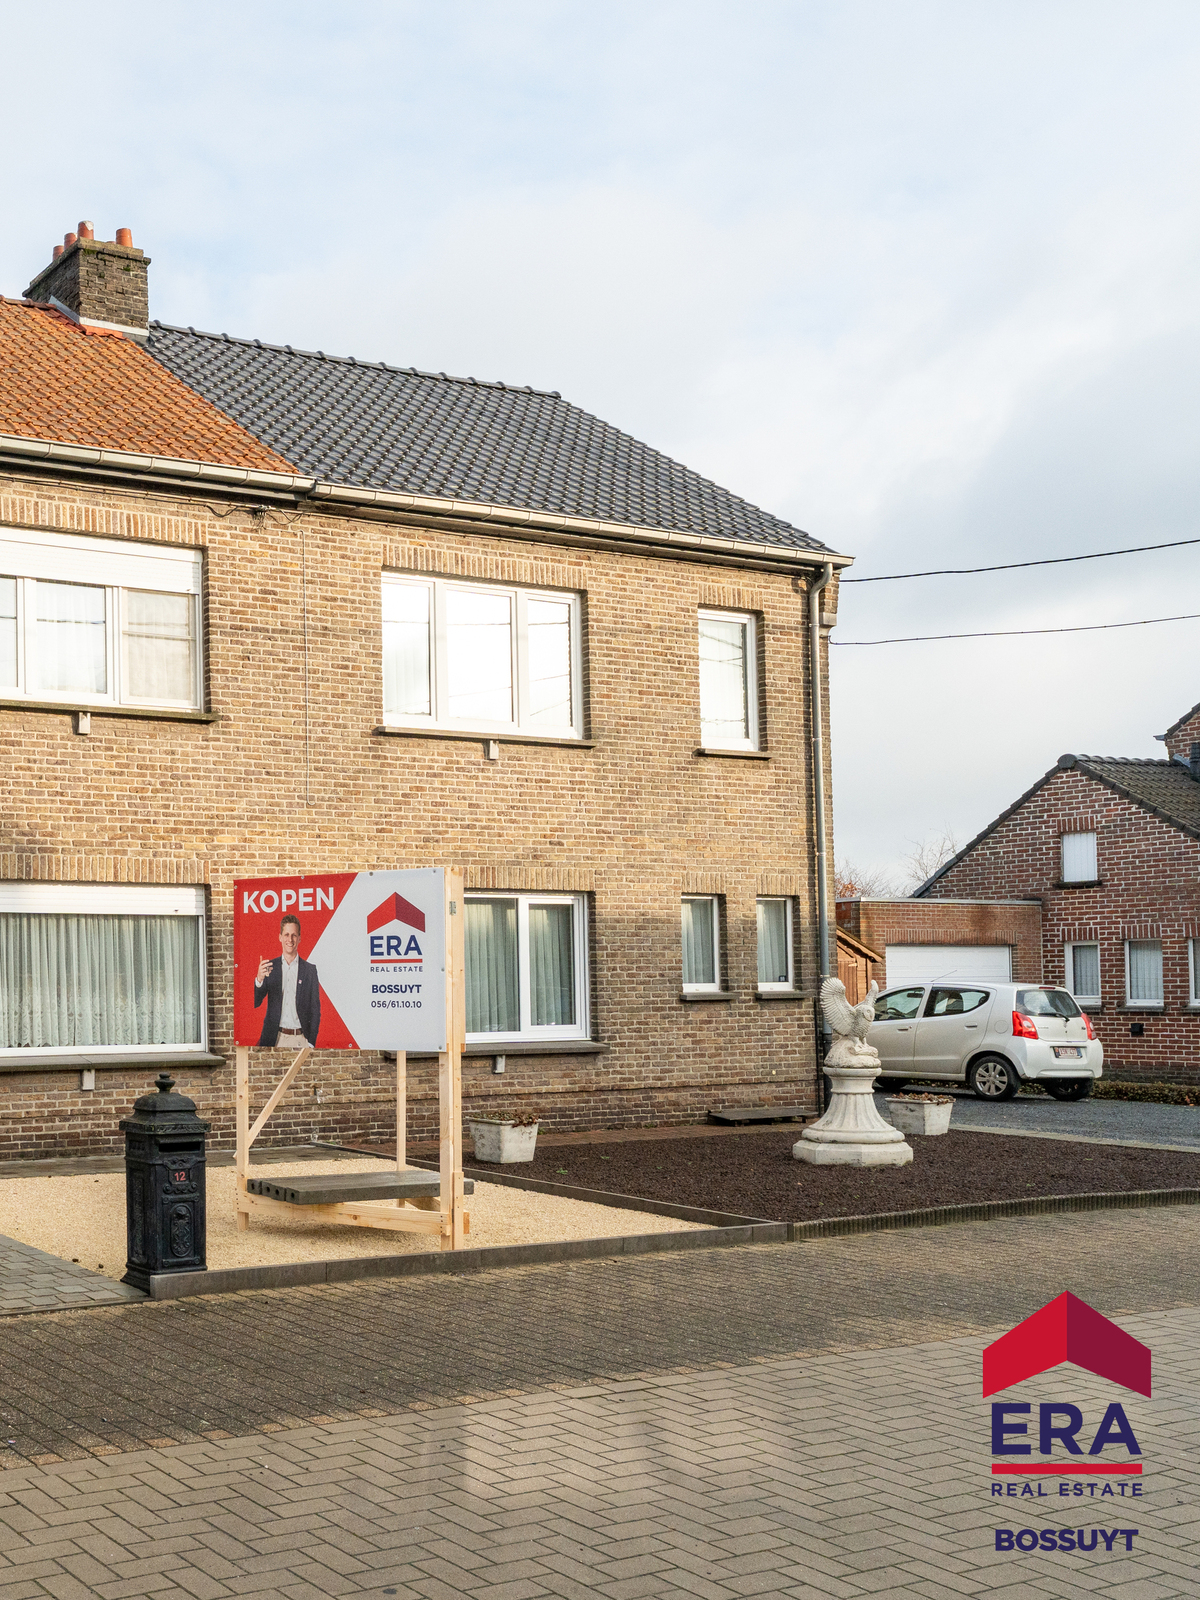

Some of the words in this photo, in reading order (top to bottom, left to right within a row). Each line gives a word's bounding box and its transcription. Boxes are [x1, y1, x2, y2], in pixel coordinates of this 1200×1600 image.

[243, 886, 334, 914] KOPEN
[369, 934, 423, 957] ERA
[393, 965, 423, 973] ESTATE
[371, 984, 422, 994] BOSSUYT
[370, 1000, 422, 1009] 056/61.10.10
[174, 1171, 186, 1182] 12
